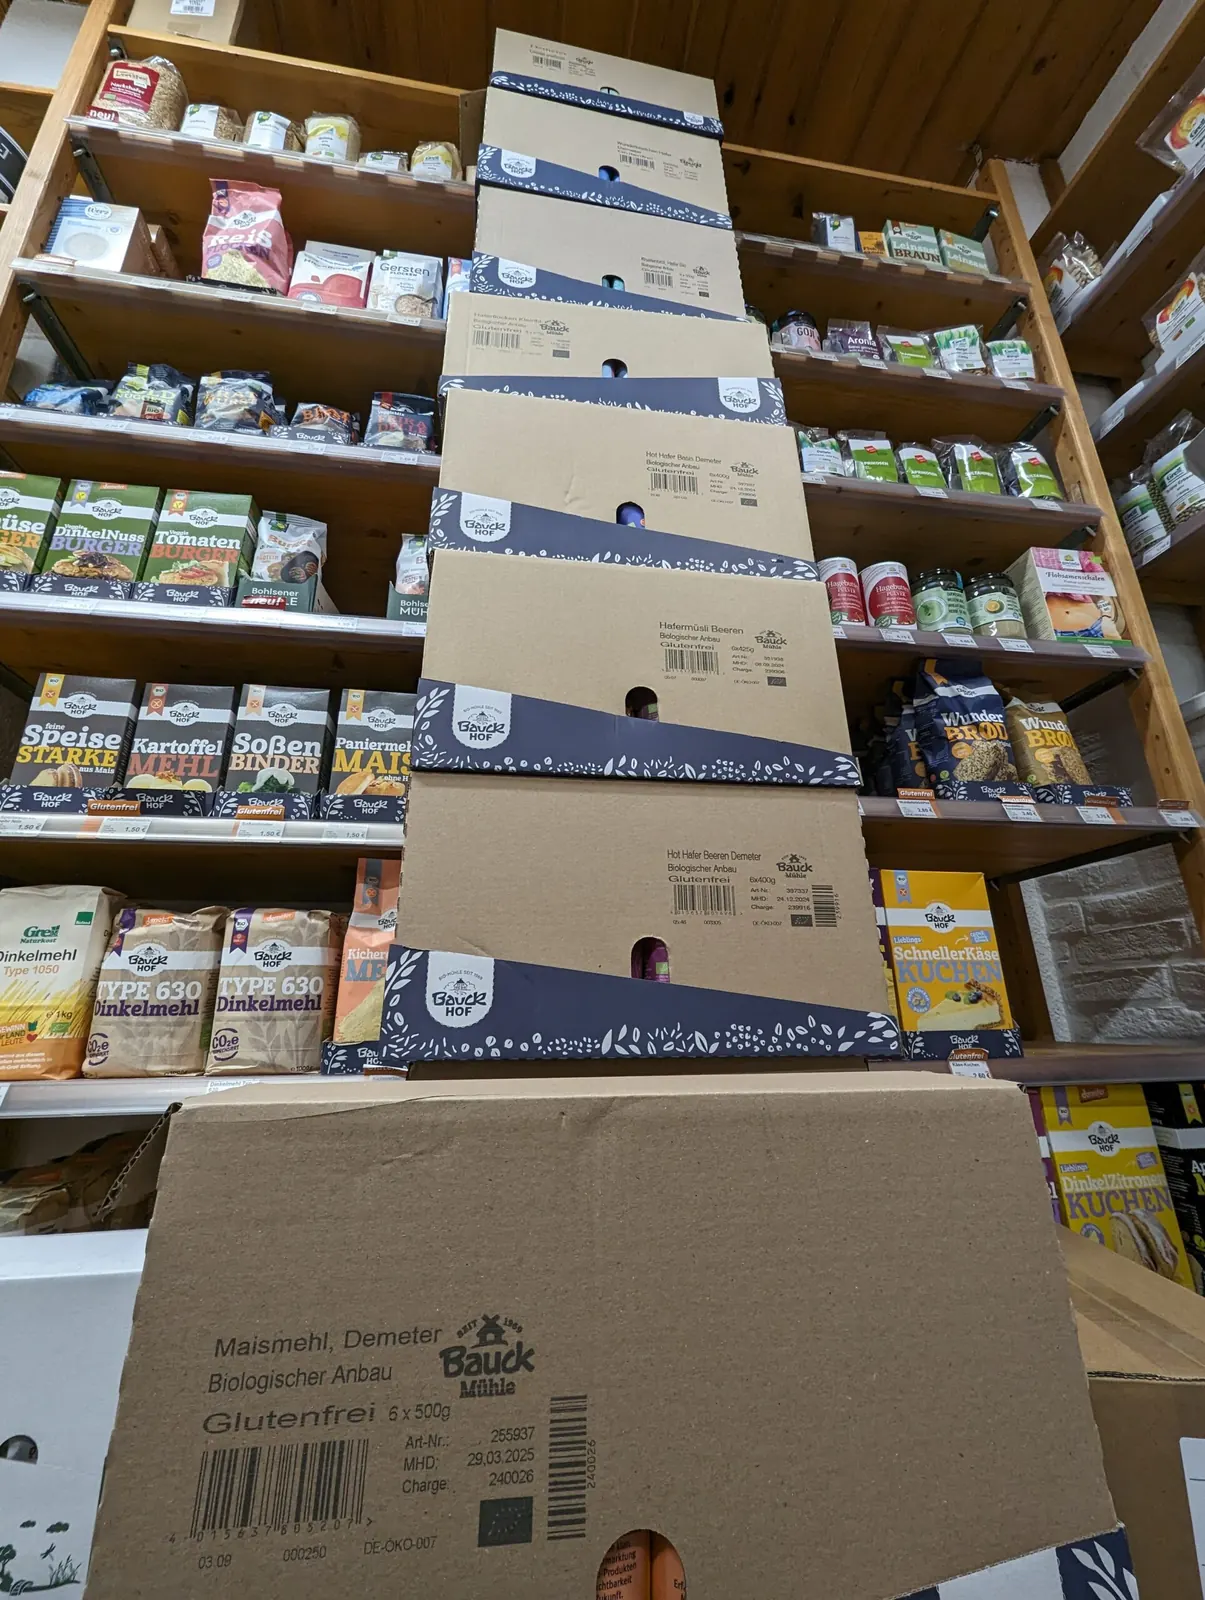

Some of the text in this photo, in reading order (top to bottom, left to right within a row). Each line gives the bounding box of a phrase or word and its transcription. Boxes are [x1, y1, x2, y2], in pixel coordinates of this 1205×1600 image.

[89, 109, 116, 121] neu!
[208, 229, 273, 248] Reis
[894, 248, 941, 263] BRAUN
[380, 262, 430, 277] Gersten
[539, 323, 570, 333] Bauck
[847, 336, 877, 347] Aronia
[722, 394, 757, 406] Bauck
[732, 401, 750, 409] HOF
[646, 459, 681, 468] Biologischer
[658, 452, 676, 460] Hafer
[695, 456, 722, 465] Demeter
[646, 467, 695, 476] Glutenfrei
[730, 465, 759, 475] Bauck
[92, 505, 123, 514] Bauck
[188, 514, 219, 523] Bauck
[463, 519, 507, 531] Bauck
[53, 525, 146, 543] DinkelNuss
[474, 528, 495, 537] HOF
[155, 530, 241, 549] Tomaten
[49, 536, 144, 557] BURGER
[150, 544, 239, 563] BURGER
[63, 583, 100, 595] Bauck
[166, 588, 200, 599] Bauck
[251, 587, 300, 597] Bohlsener
[659, 621, 744, 635] Hafermüsli Beeren
[659, 632, 721, 643] Biologischer Anbau
[754, 635, 788, 646] Bauck
[660, 641, 715, 651] Glutenfrei
[63, 701, 97, 712] Bauck
[169, 710, 200, 719] Bauck
[267, 710, 298, 720] Bauck
[367, 715, 397, 725] Bauck
[940, 709, 1004, 727] Wunder
[45, 722, 66, 731] feine
[457, 720, 505, 734] Bauck
[943, 722, 1009, 742] BRØD
[20, 724, 122, 750] Speise
[469, 732, 493, 741] HOF
[133, 737, 223, 756] Kartoffel
[232, 732, 322, 757] Soßen
[15, 745, 119, 767] STÄRKE
[332, 749, 412, 775] MAIS
[128, 753, 219, 777] MEHL
[230, 753, 320, 775] BINDER
[94, 766, 115, 775] Mais
[980, 785, 1006, 794] Bauck
[33, 791, 73, 802] Bauck
[135, 792, 174, 803] Bauck
[248, 796, 285, 808] Bauck
[40, 800, 61, 808] HOF
[89, 802, 139, 812] Glutenfrei
[353, 798, 388, 809] Bauck
[237, 807, 283, 816] Glutenfrei
[667, 849, 762, 862] Hot Hafer Beeren Demeter
[667, 863, 737, 875] Biologischer Anbau
[776, 862, 813, 873] Bauck
[668, 875, 731, 884] Glutenfrei
[749, 876, 776, 885] 6x400g
[776, 895, 810, 903] 24.12.2024
[924, 913, 956, 923] Bauck
[19, 937, 57, 945] Naturkost
[893, 936, 922, 944] Lieblings
[253, 951, 292, 962] Bauck
[893, 945, 1000, 961] SchnellerKäse
[128, 955, 169, 966] Bauck
[262, 960, 282, 968] HOF
[3, 964, 60, 976] Type 1050
[896, 959, 1003, 984] KUCHEN
[97, 980, 202, 1001] TYPE 630
[219, 976, 324, 995] TYPE 630
[216, 996, 322, 1012] Dinkelmehl
[431, 991, 487, 1006] Bauck
[94, 999, 200, 1017] Dinkelmehl
[445, 1006, 472, 1017] HOF
[949, 1034, 980, 1045] Bauck
[1088, 1134, 1121, 1146] Bauck
[1099, 1145, 1115, 1153] HOF
[1060, 1163, 1089, 1173] Lieblings
[1065, 1186, 1174, 1220] KUCHEN
[456, 1317, 524, 1339] SEIT 1969
[215, 1326, 443, 1359] Maismehl, Demeter
[439, 1340, 535, 1379] Bauck
[207, 1363, 393, 1395] Biologischer Anbau
[459, 1378, 517, 1399] Mühle
[388, 1402, 452, 1422] 6 x 500g
[202, 1402, 376, 1435] Glutenfrei
[404, 1426, 536, 1451] Art-Nr.: 255937
[403, 1448, 535, 1471] MHD: 29.03.2025
[586, 1438, 598, 1489] 240026
[402, 1469, 535, 1494] Charge: 240026
[282, 1536, 438, 1562] 000250 DE-ÖKO-007
[604, 1562, 637, 1577] Produkten
